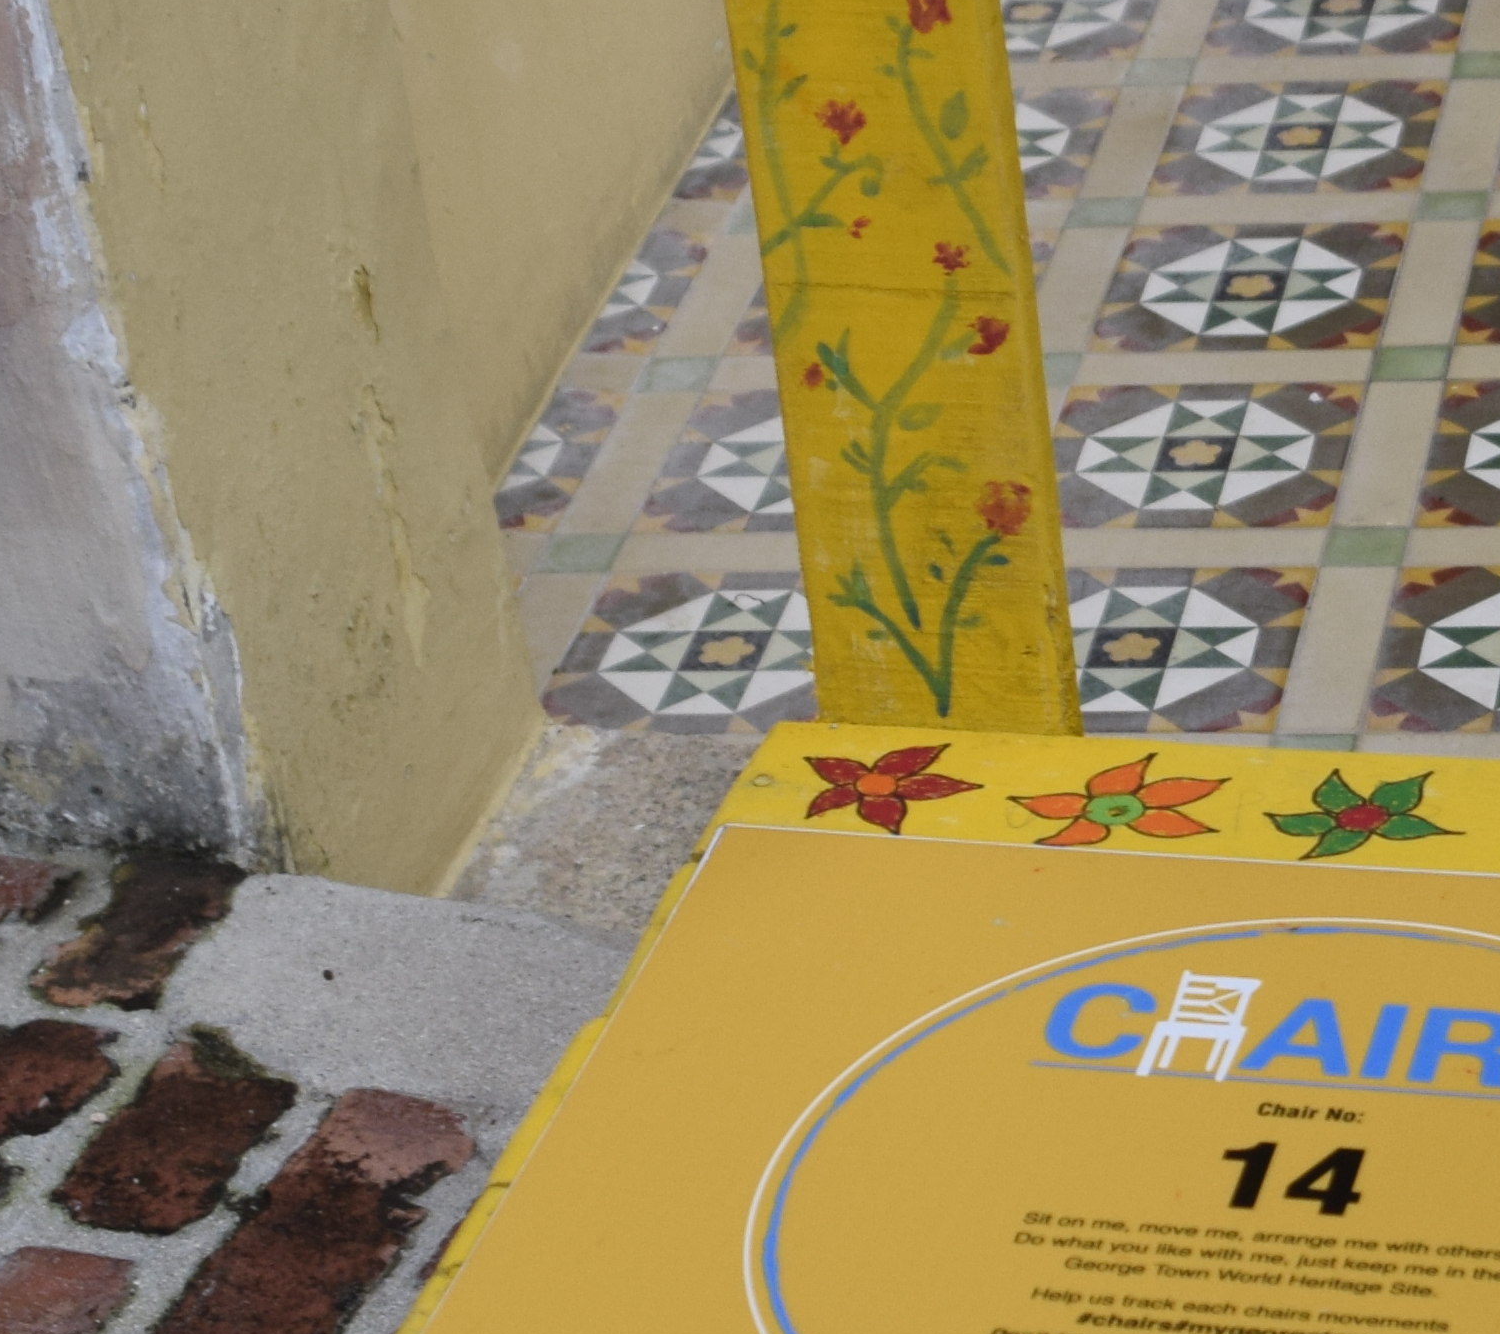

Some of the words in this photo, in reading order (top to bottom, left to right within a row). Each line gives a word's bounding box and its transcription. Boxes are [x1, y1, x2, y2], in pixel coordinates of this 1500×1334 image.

[1257, 1103, 1318, 1121] Chair
[1325, 1106, 1365, 1124] No:
[1220, 1142, 1365, 1217] 14
[1014, 1231, 1044, 1245] Do
[1052, 1235, 1103, 1249] what
[1108, 1241, 1148, 1255] you
[1156, 1243, 1192, 1257] like
[1200, 1247, 1242, 1261] with
[1250, 1252, 1288, 1267] me,
[1296, 1254, 1337, 1269] just
[1343, 1257, 1397, 1274] keep
[1404, 1263, 1438, 1277] me
[1446, 1265, 1465, 1279] in
[1023, 1210, 1051, 1225] Sit
[1057, 1217, 1085, 1228] on
[1091, 1218, 1130, 1233] me,
[1138, 1222, 1198, 1237] move
[1252, 1230, 1337, 1249] arrange
[1344, 1237, 1378, 1251] me
[1386, 1241, 1429, 1255] with
[1064, 1257, 1146, 1276] George
[1155, 1264, 1209, 1279] Town
[1217, 1269, 1282, 1286] World
[1288, 1274, 1382, 1295] Heritage
[1389, 1282, 1437, 1298] Site.
[1031, 1287, 1082, 1305] Help
[1089, 1295, 1114, 1306] us
[1122, 1296, 1176, 1311] track
[1182, 1299, 1236, 1315] each
[1244, 1305, 1310, 1321] chairs
[1317, 1310, 1449, 1333] movements
